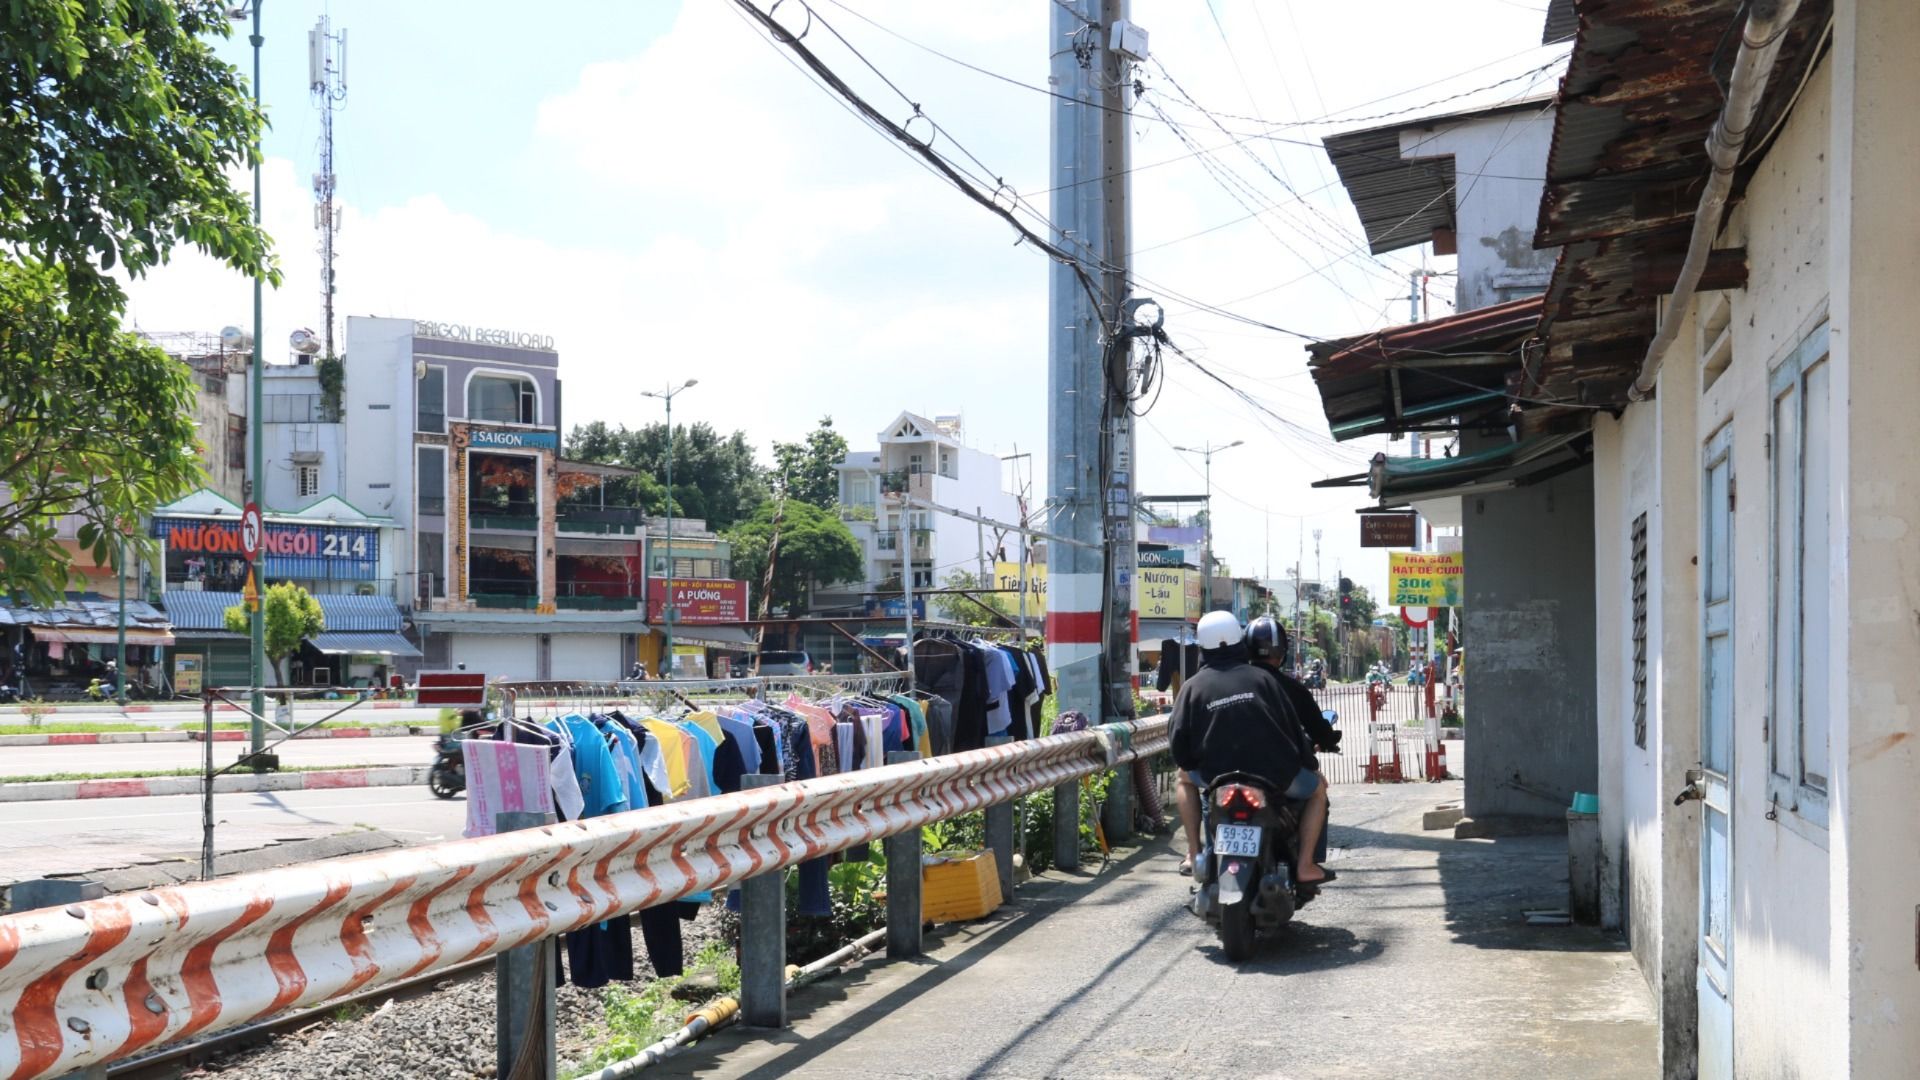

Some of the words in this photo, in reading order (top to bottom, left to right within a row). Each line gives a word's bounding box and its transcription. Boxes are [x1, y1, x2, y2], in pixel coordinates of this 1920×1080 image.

[416, 320, 472, 341] SAIGON
[479, 431, 523, 447] SAIGON
[170, 523, 243, 552] NƯỚN
[323, 534, 367, 557] 214
[1144, 570, 1179, 585] Nướng
[678, 590, 685, 600] A
[1223, 827, 1255, 840] 59-S2
